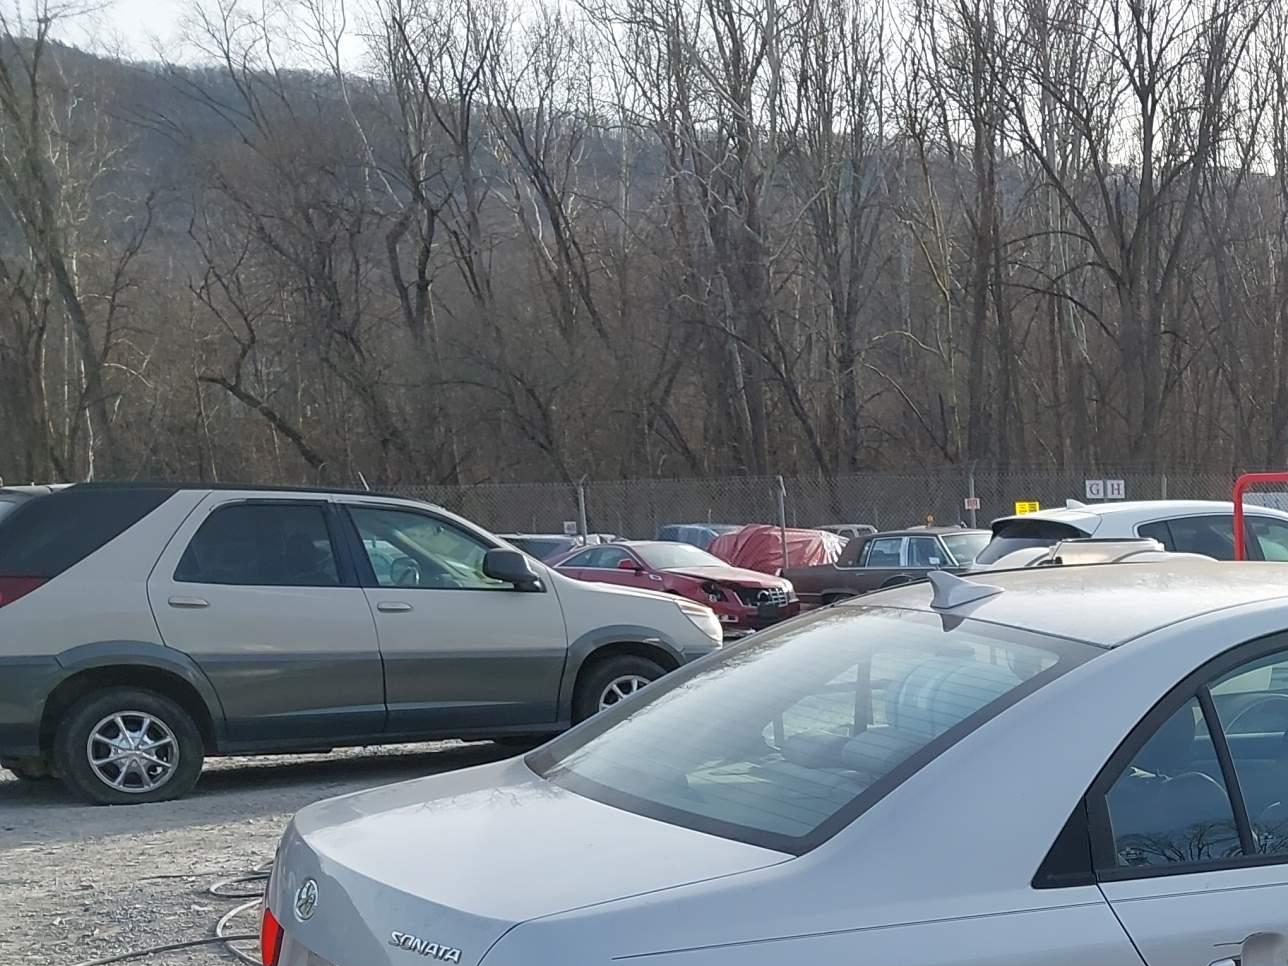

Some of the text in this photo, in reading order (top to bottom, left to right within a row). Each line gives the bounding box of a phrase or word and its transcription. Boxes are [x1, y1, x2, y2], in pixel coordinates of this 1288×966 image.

[1089, 482, 1122, 496] G H
[388, 931, 462, 965] SONATA
